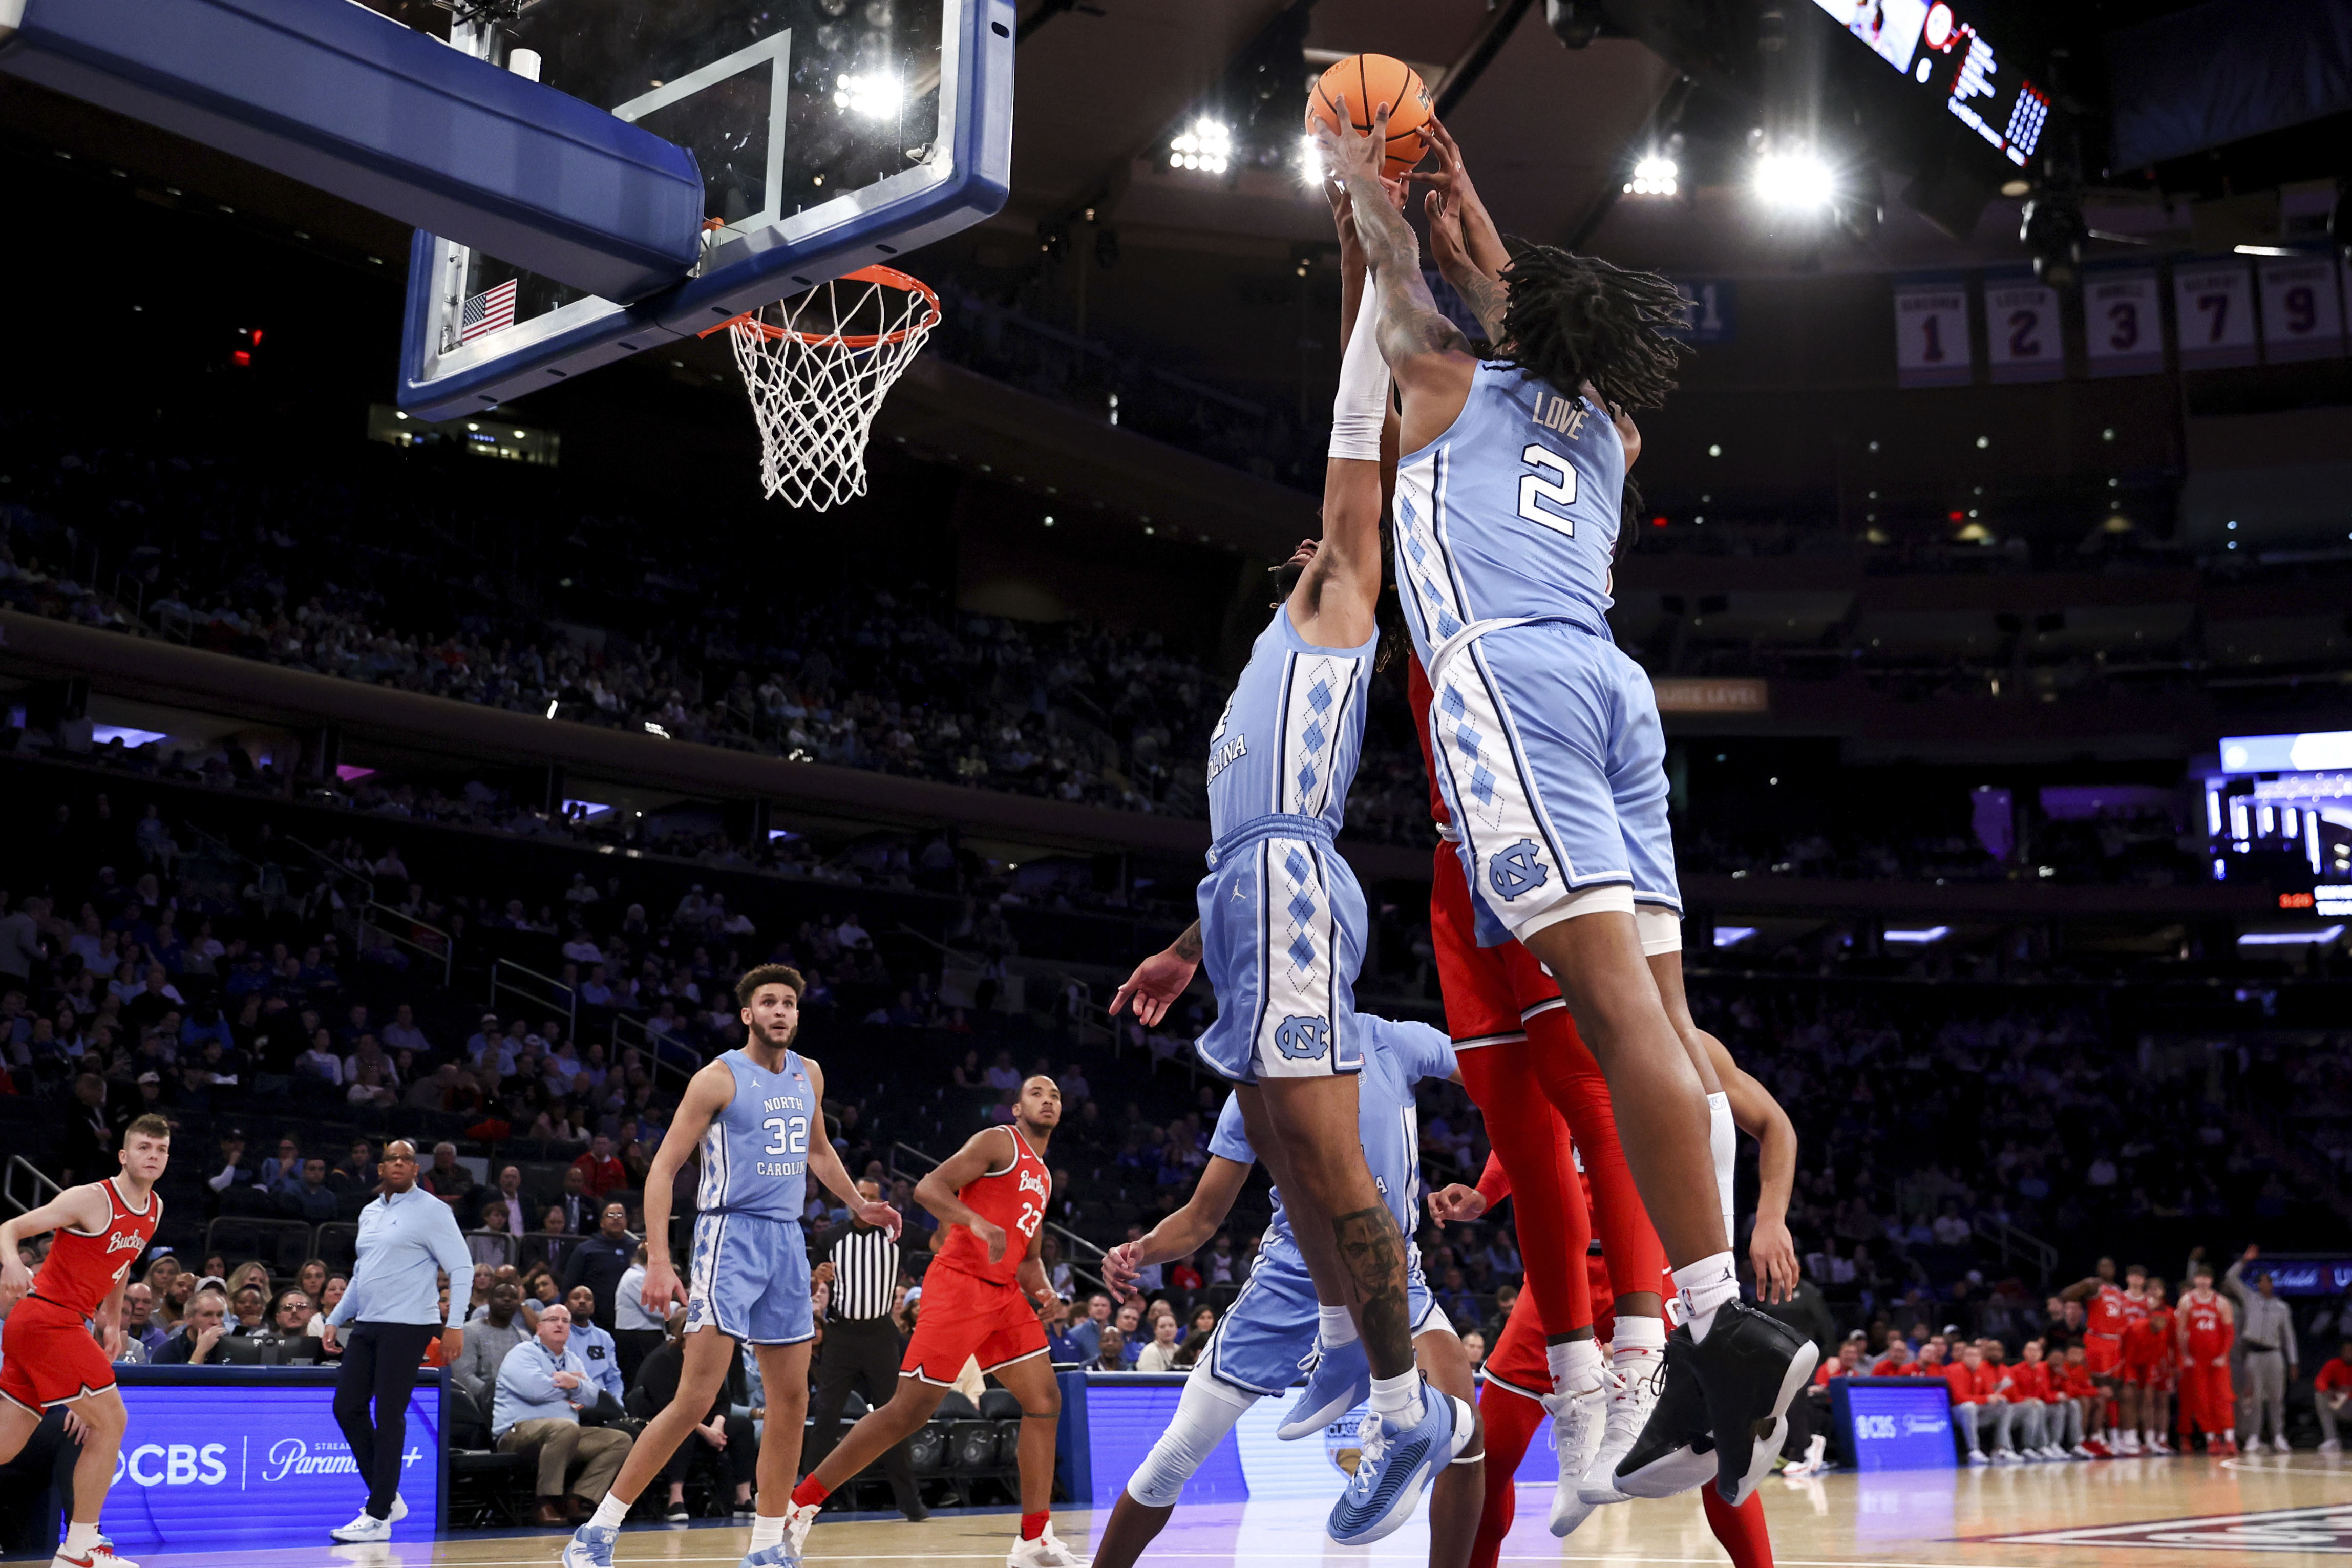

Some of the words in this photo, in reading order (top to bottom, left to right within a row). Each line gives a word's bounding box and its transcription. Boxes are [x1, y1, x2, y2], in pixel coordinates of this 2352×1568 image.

[2008, 310, 2039, 357] 2
[2108, 302, 2139, 350] 3
[2198, 294, 2229, 342] 7
[2284, 286, 2317, 334] 9
[1923, 314, 1944, 362] 1
[1532, 391, 1589, 441] LOVE
[1518, 442, 1578, 539] 2
[1206, 733, 1247, 788] OLINA
[763, 1096, 804, 1114] NORTH
[762, 1115, 808, 1156] 32
[756, 1160, 806, 1177] CAROLIN
[1016, 1201, 1043, 1238] 23
[111, 1259, 131, 1284] 4
[1327, 1422, 1359, 1438] CLASS
[128, 1443, 227, 1487] CBS
